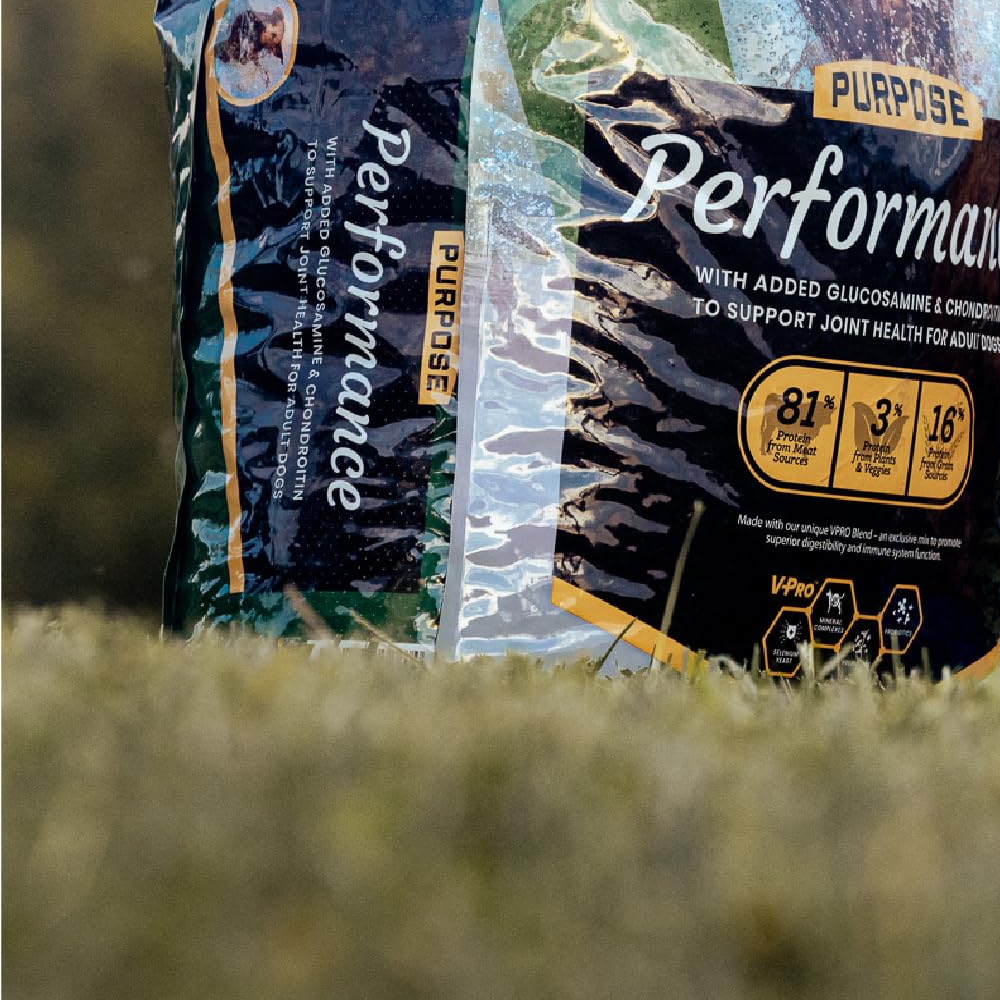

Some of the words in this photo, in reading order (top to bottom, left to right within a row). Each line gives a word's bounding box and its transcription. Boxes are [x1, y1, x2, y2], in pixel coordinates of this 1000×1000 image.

[832, 71, 970, 127] PURPOSE
[307, 139, 317, 161] TO
[325, 135, 338, 178] WITH
[300, 167, 316, 241] SUPPORT
[319, 183, 332, 240] ADDED
[297, 245, 310, 294] JOINT
[695, 265, 748, 290] WITH
[753, 274, 821, 298] ADDED
[827, 283, 932, 314] GLUCOSAMINE
[934, 296, 942, 314] &
[311, 245, 331, 365] GLUCOSAMINE
[327, 120, 412, 511] Performance
[425, 244, 460, 393] PURPOSE
[693, 297, 720, 317] TO
[727, 302, 816, 329] SUPPORT
[820, 314, 869, 338] JOINT
[873, 321, 923, 344] HEALTH
[925, 326, 949, 347] FOR
[292, 296, 308, 360] HEALTH
[287, 363, 301, 393] FOR
[308, 369, 320, 379] &
[280, 397, 297, 448] ADULT
[777, 387, 836, 428] 81%
[870, 398, 903, 437] 3%
[292, 383, 317, 501] CHONDROITIN
[766, 439, 791, 453] from
[792, 443, 817, 456] Meat
[776, 430, 811, 444] Protein
[851, 449, 873, 464] from
[873, 453, 896, 465] Plants
[863, 440, 890, 454] Protein
[273, 453, 288, 499] DOGS
[773, 452, 809, 466] Sources
[863, 463, 891, 478] Veggies
[737, 514, 763, 528] Made
[765, 518, 784, 530] with
[785, 522, 801, 532] our
[801, 523, 829, 537] unique
[852, 527, 873, 540] Blend
[766, 534, 801, 548] superior
[801, 537, 847, 555] digestibility
[847, 543, 862, 554] and
[862, 543, 891, 556] immune
[892, 548, 915, 560] system
